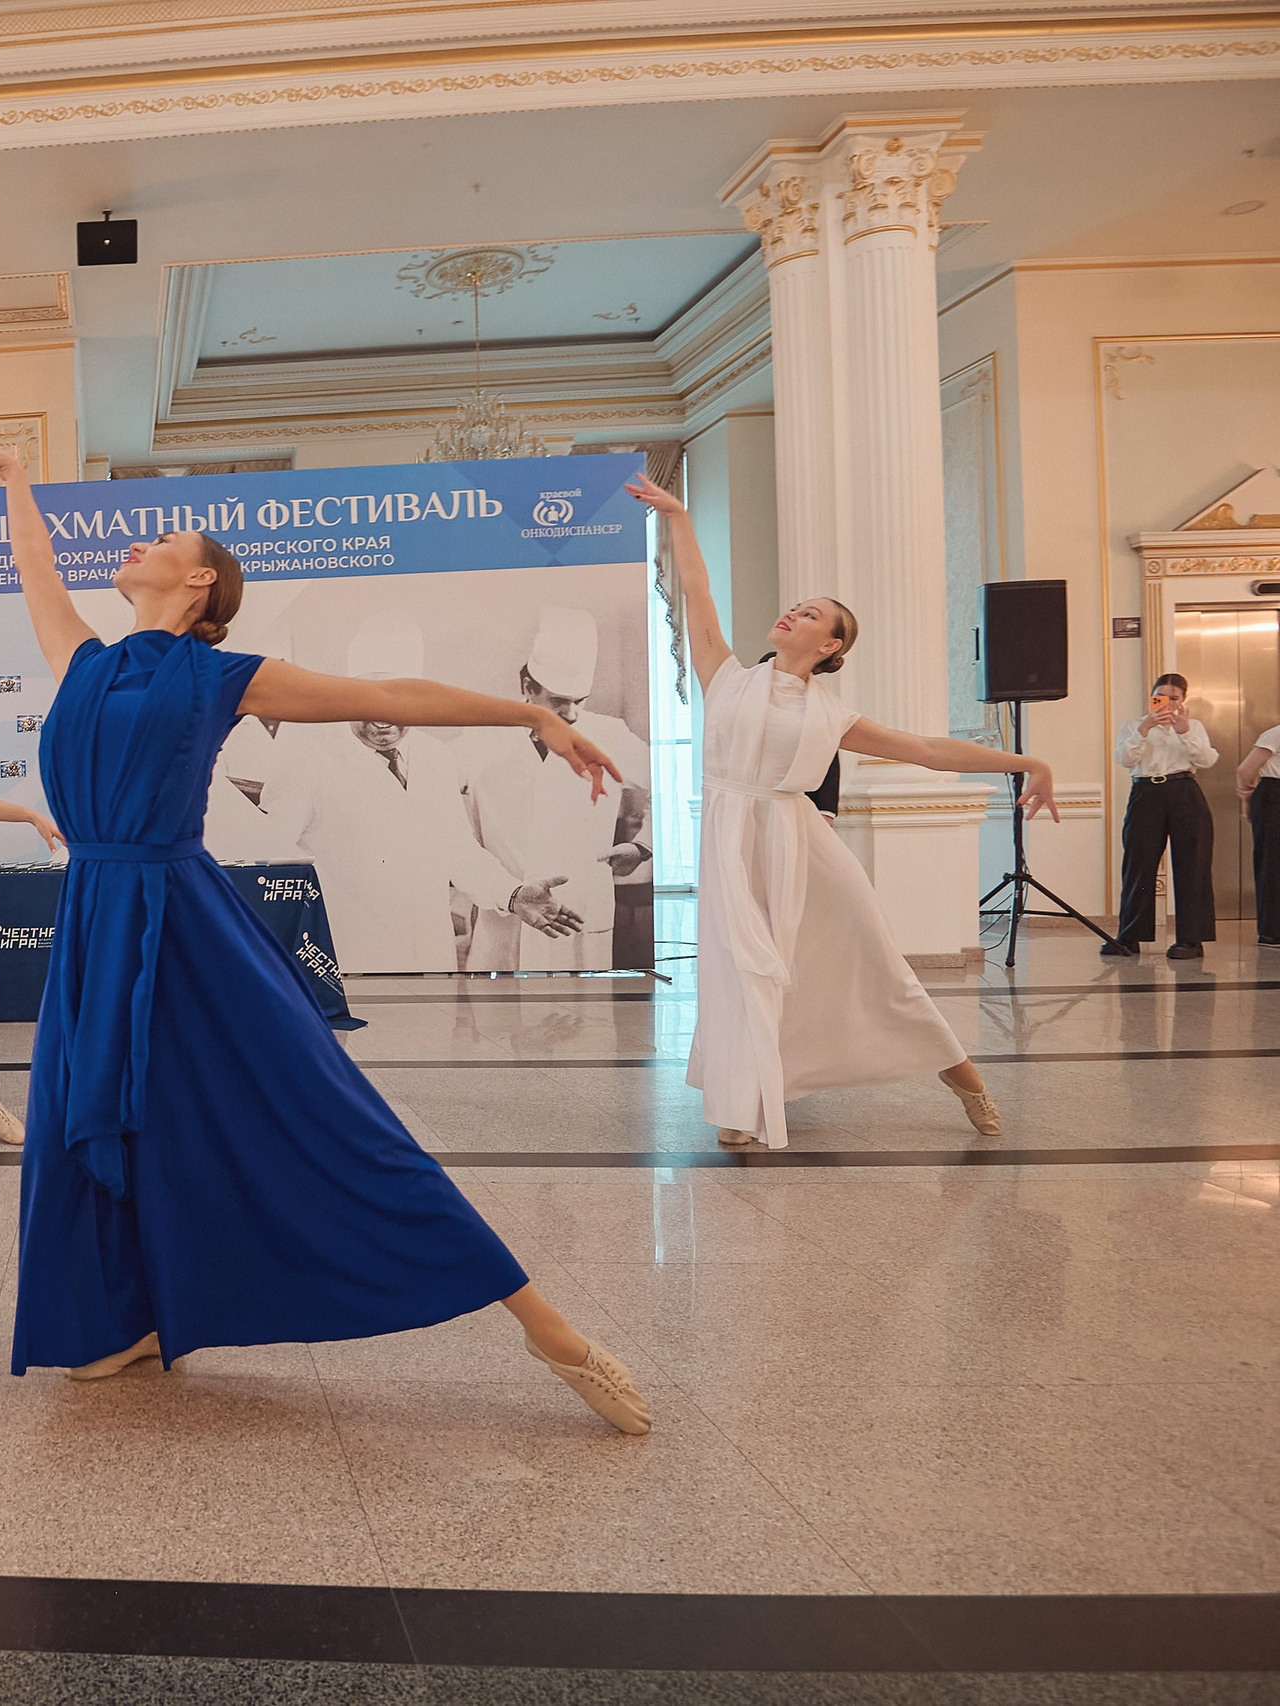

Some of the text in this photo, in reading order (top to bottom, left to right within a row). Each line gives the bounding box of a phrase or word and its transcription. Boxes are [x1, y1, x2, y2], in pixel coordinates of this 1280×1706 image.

[257, 489, 503, 530] ФЕСТИВАЛЬ
[521, 524, 623, 539] ОНКОДИСПАНСЕР
[222, 538, 337, 557] НОЯРСКОГО
[342, 535, 391, 551] КРАЯ
[68, 569, 119, 582] ВРАЧА
[240, 553, 395, 573] КРЫЖАНОВСКОГО
[263, 890, 302, 901] ИГРА
[2, 927, 56, 938] ЧЕСТНА
[0, 939, 38, 949] ИГРА
[296, 947, 327, 978] ИГРА
